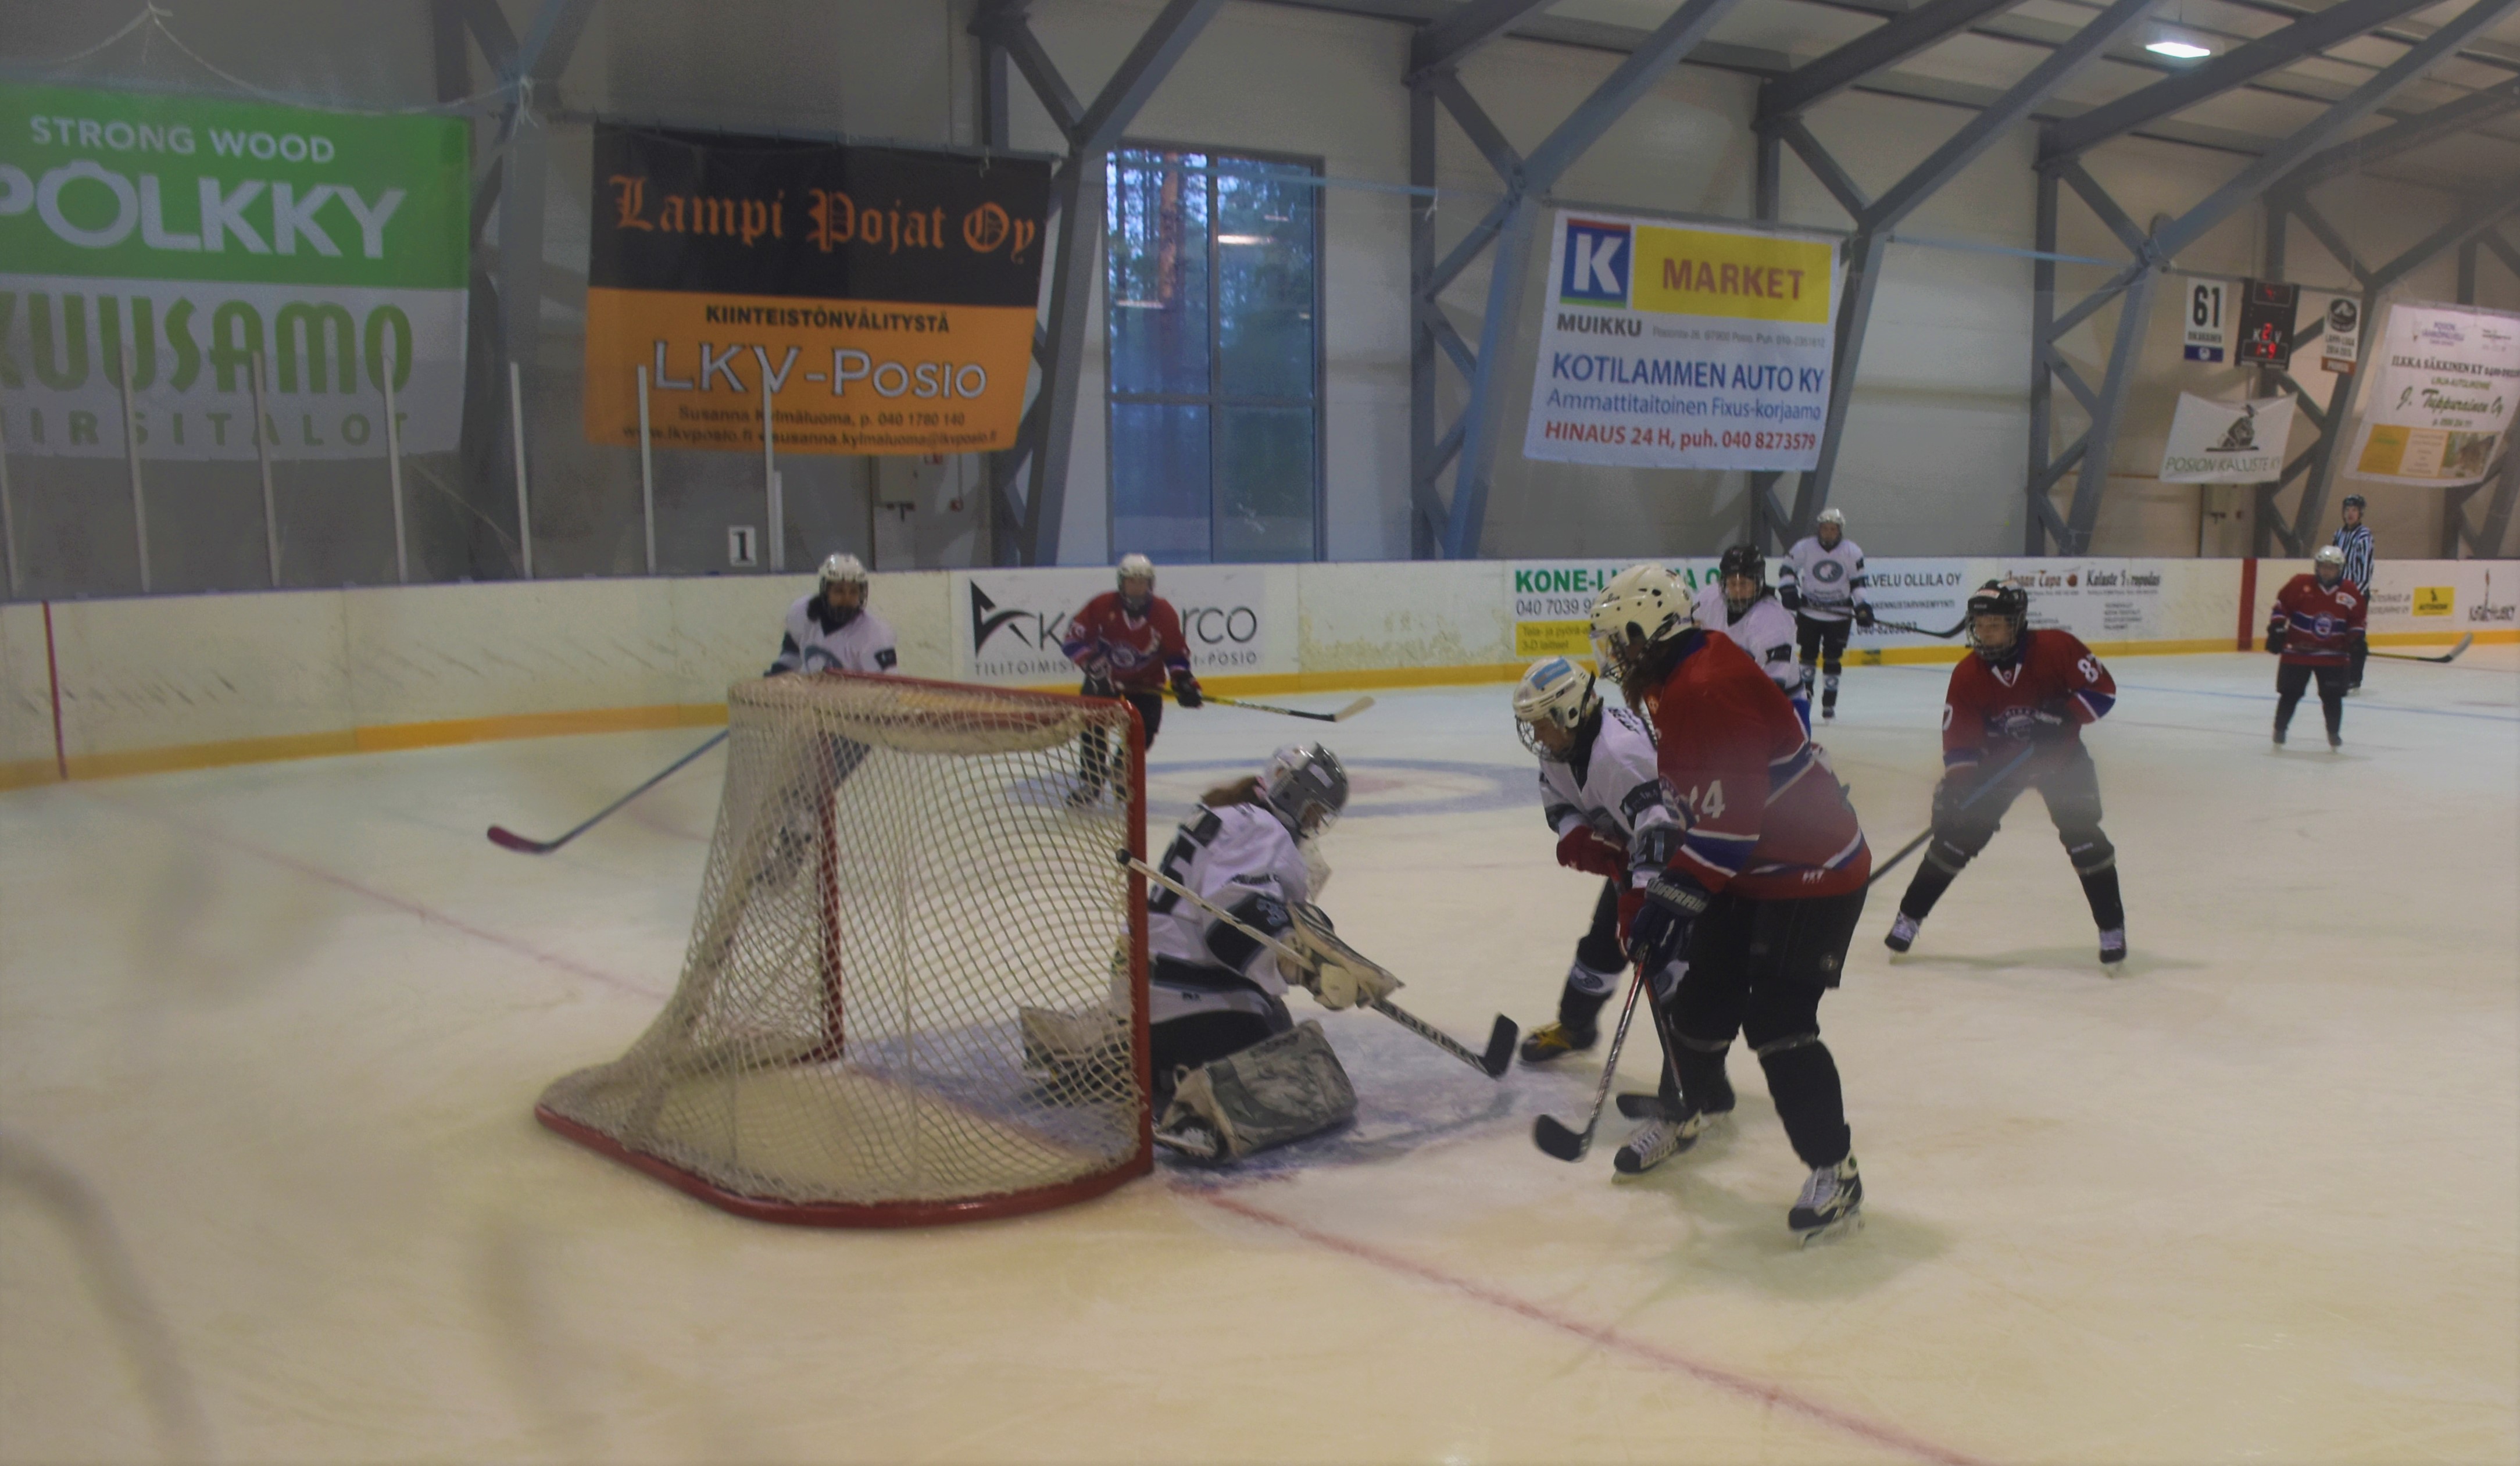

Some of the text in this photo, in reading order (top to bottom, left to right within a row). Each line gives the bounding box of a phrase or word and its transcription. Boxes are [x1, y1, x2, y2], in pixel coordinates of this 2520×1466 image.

[31, 116, 335, 164] STRONG WOOD
[609, 175, 1035, 264] Lampi Pojat Oy
[1573, 233, 1623, 294] K
[1663, 258, 1805, 301] MARKET
[706, 305, 950, 333] KIINTEISTÖNVÄLITYSTÄ
[2193, 284, 2220, 328] 61
[1556, 313, 1642, 337] MUIKKU
[1552, 352, 1825, 393] KOTILAMMEN AUTO KY
[2391, 355, 2421, 369] ILKKA
[1546, 388, 1821, 424] Ammattitaitoinen Fixus-korjaamo
[1545, 421, 1816, 450] HINAUS 24 H, puh. 040 8273579
[734, 531, 750, 562] 1
[1863, 571, 1962, 587] LVELU OLLILA OY
[1516, 598, 1542, 616] 040
[1546, 598, 1579, 615] 7039
[974, 660, 1076, 677] TILITOIMIST
